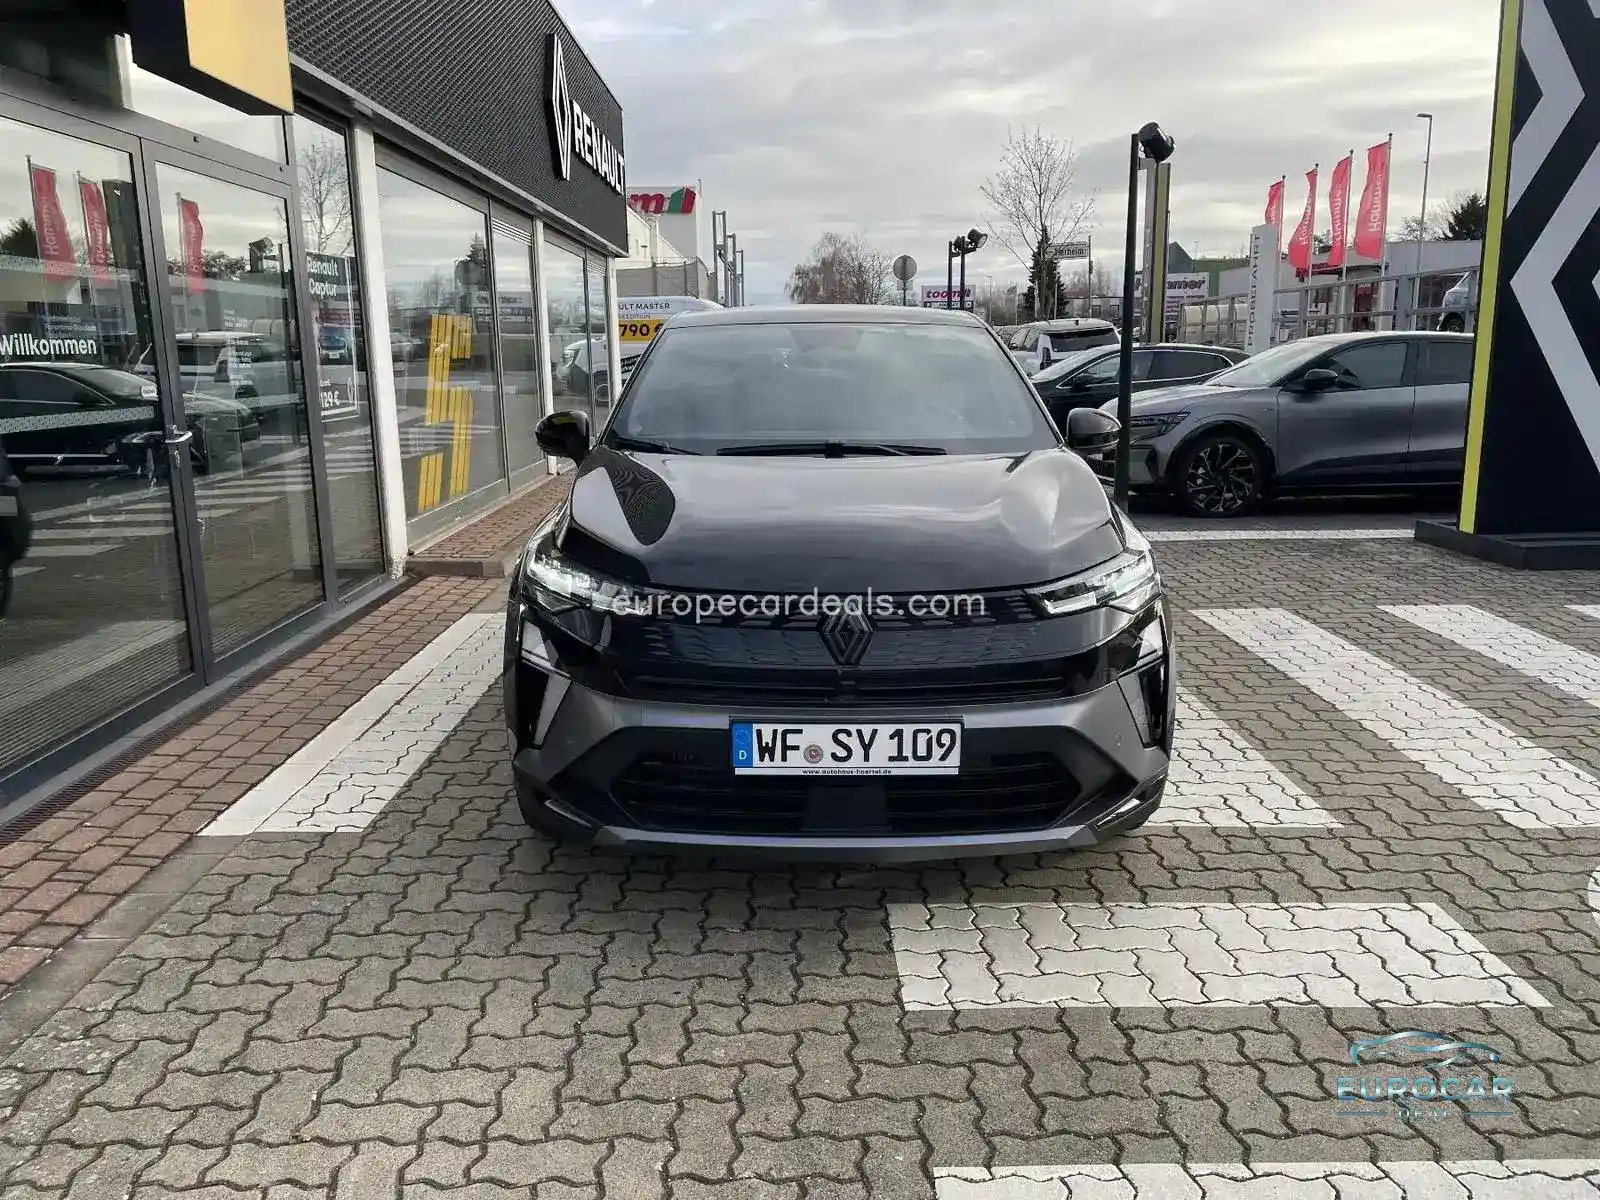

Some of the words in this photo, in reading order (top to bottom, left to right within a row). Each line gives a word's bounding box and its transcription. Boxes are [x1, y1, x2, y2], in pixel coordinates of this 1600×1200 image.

[572, 99, 625, 194] RENAULT
[306, 256, 339, 277] Renault
[308, 278, 337, 299] Captur
[1247, 234, 1260, 347] PROBEFAHRT
[636, 302, 670, 310] MASTER
[619, 323, 650, 337] 790
[0, 333, 97, 356] Willkommen
[738, 750, 747, 760] D
[756, 728, 804, 763] WF
[830, 728, 878, 763] SY
[888, 728, 957, 762] 109
